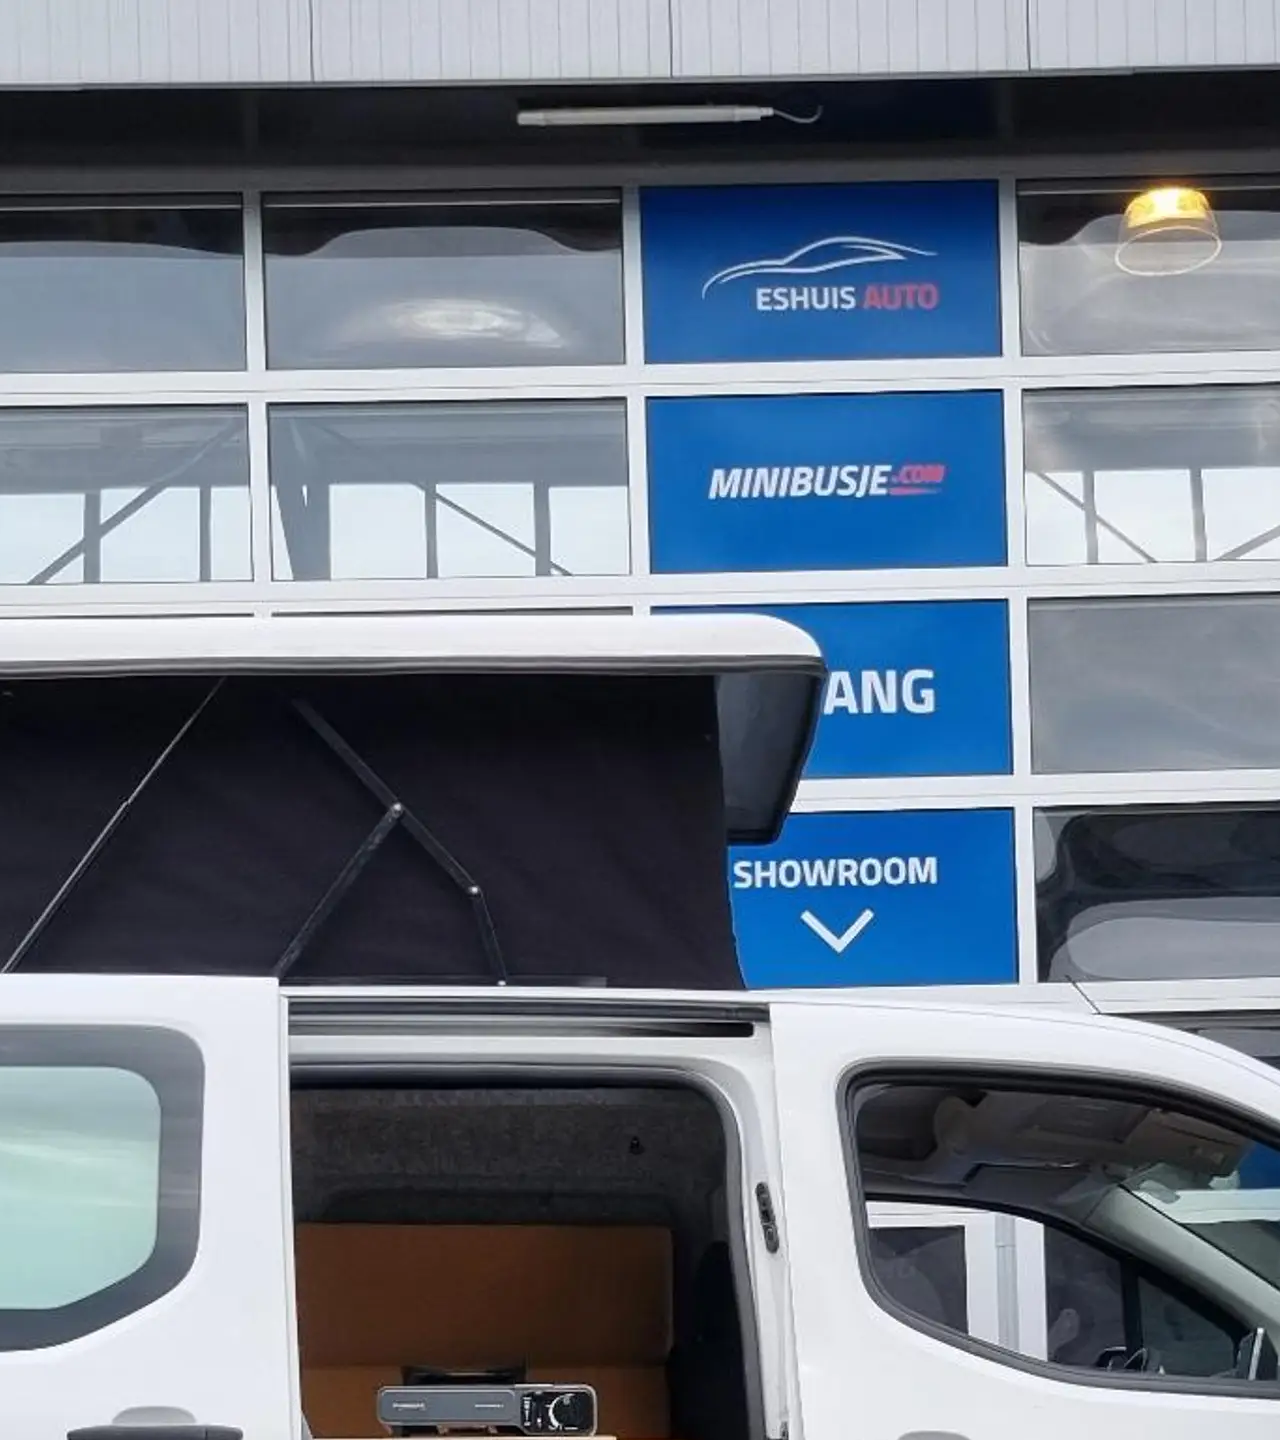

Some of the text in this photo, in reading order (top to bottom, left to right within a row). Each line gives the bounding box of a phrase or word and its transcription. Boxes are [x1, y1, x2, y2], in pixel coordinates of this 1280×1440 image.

[755, 284, 939, 311] ESHUIS AUTO
[733, 856, 938, 888] SHOWROOM
